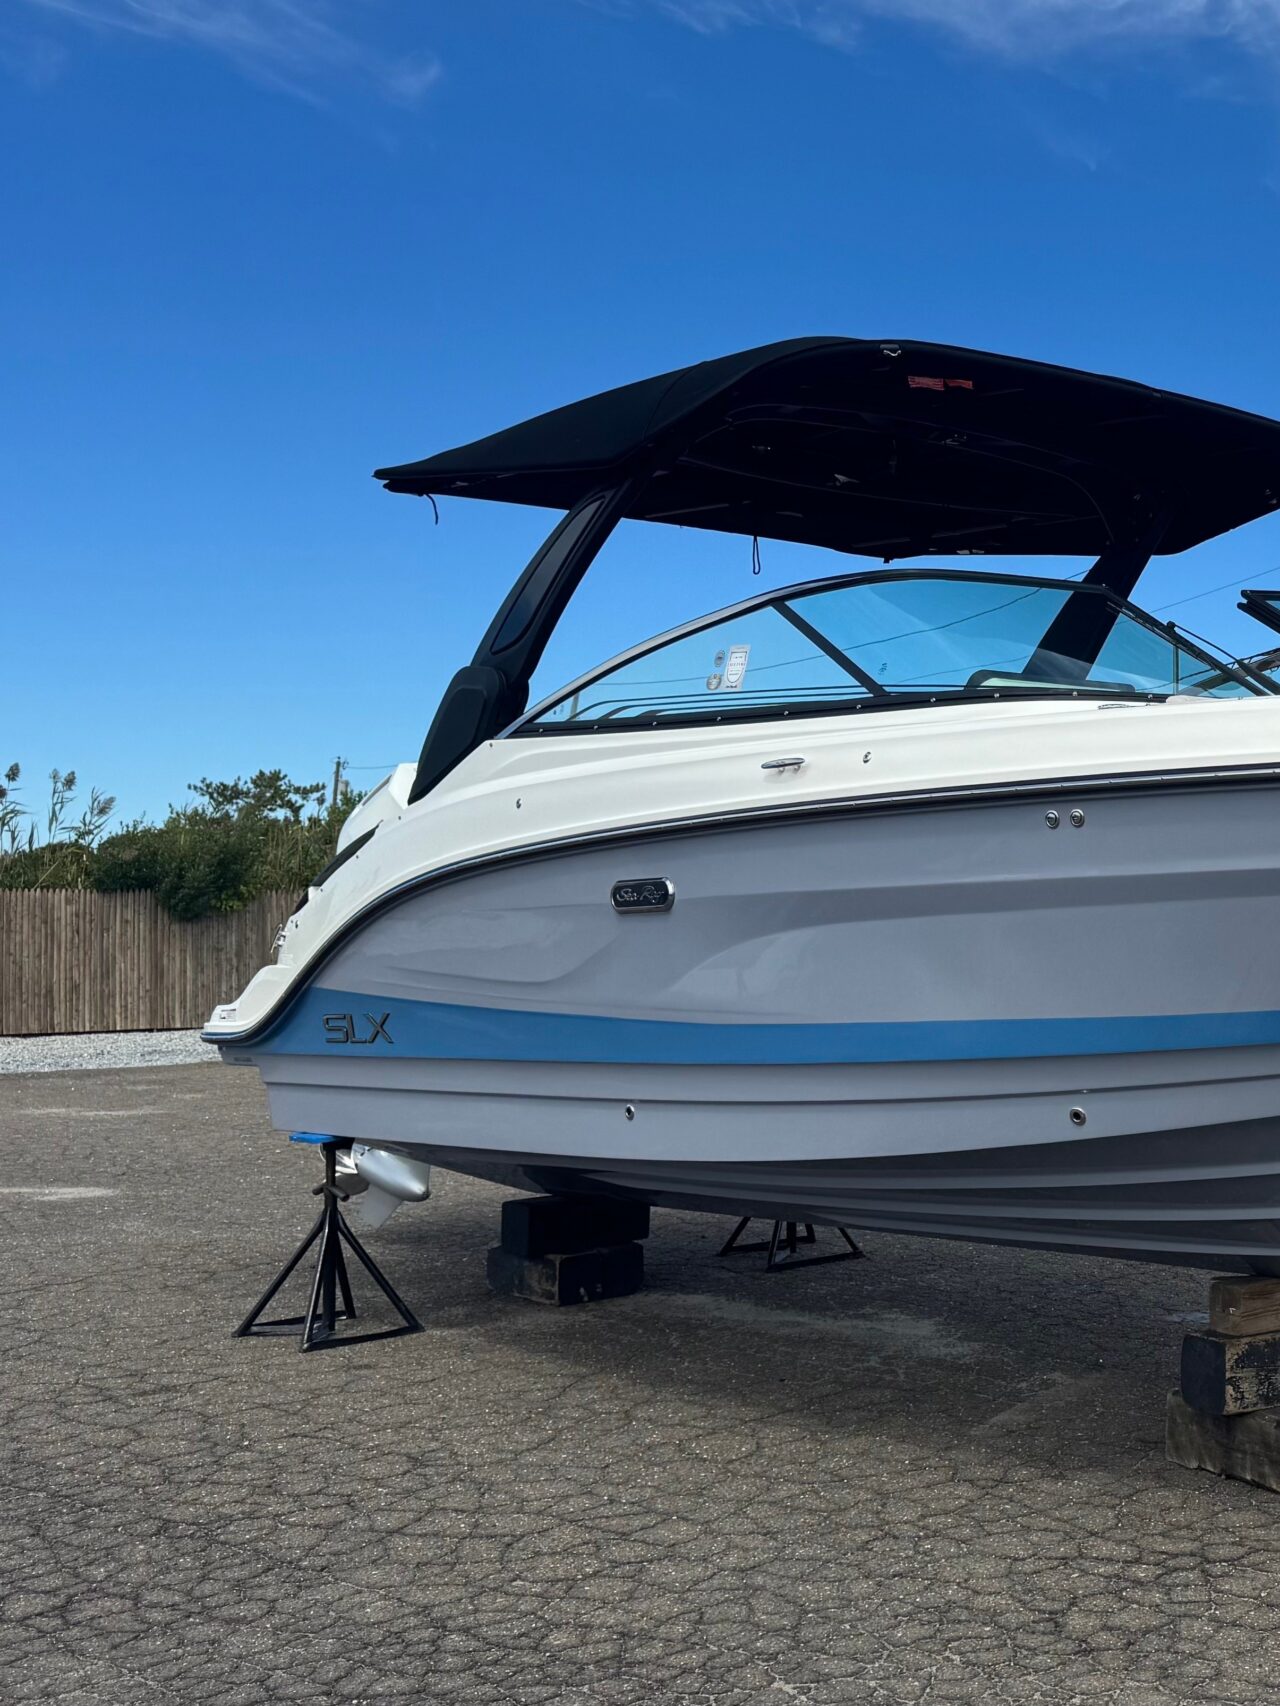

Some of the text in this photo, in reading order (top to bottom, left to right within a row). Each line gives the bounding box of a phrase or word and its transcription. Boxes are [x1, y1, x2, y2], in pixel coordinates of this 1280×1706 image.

[616, 885, 665, 904] Sea Ray
[322, 1012, 395, 1044] SLX
